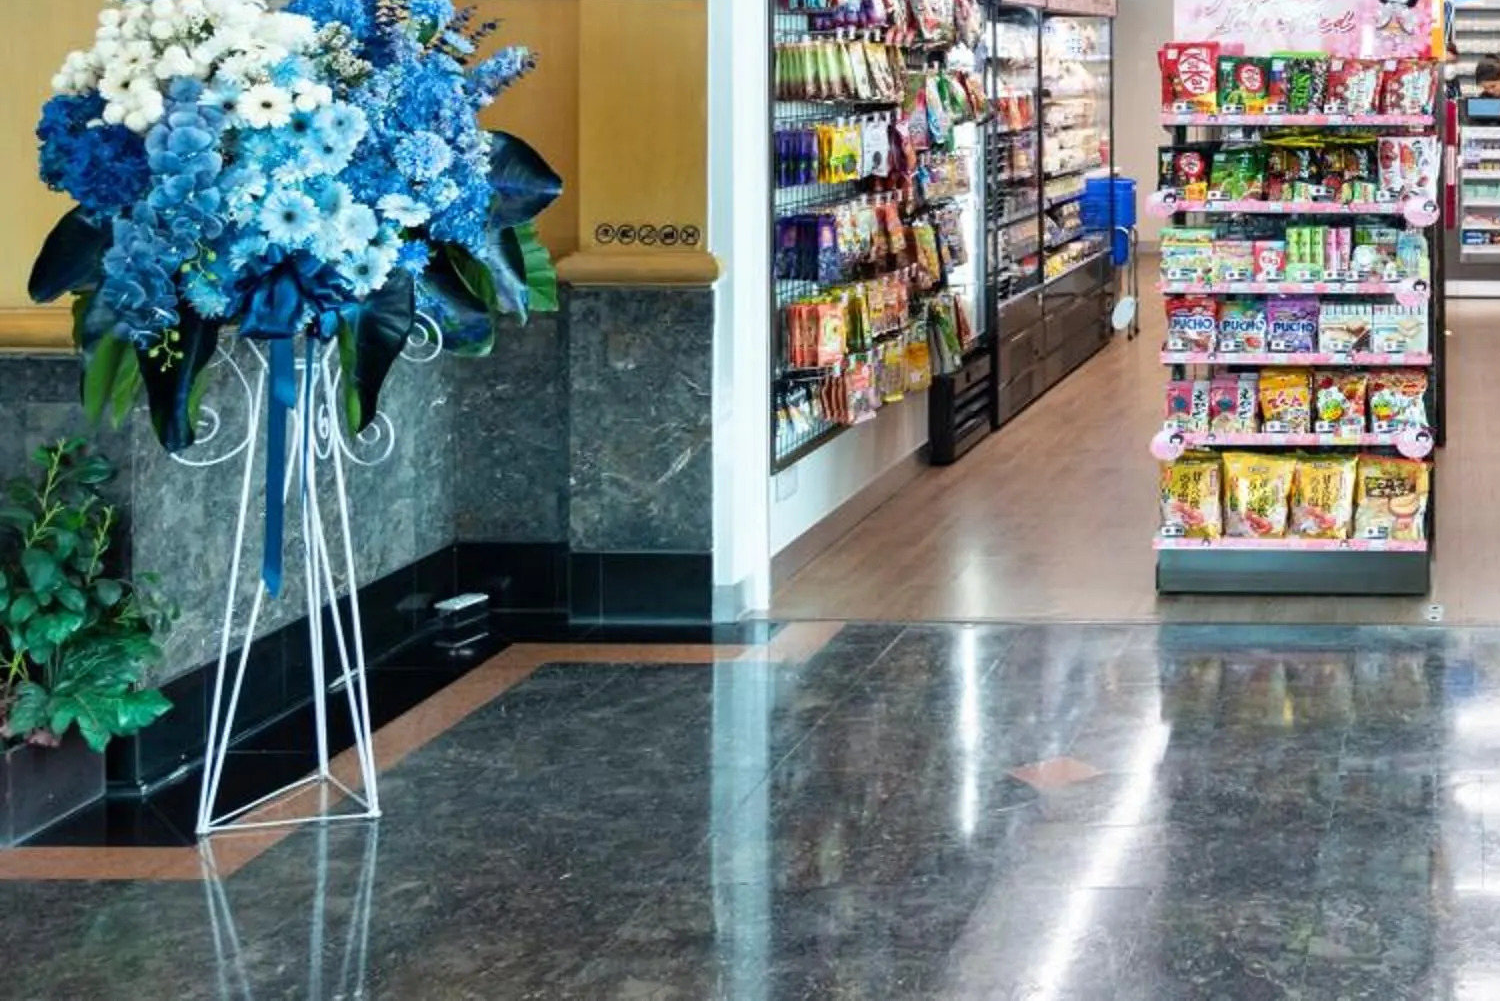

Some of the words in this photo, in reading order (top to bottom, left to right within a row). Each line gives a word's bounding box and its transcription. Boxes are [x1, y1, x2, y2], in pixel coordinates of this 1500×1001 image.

[1171, 317, 1213, 330] PUCHO
[1222, 319, 1265, 333] PUCHO
[1272, 321, 1315, 333] PUCHO
